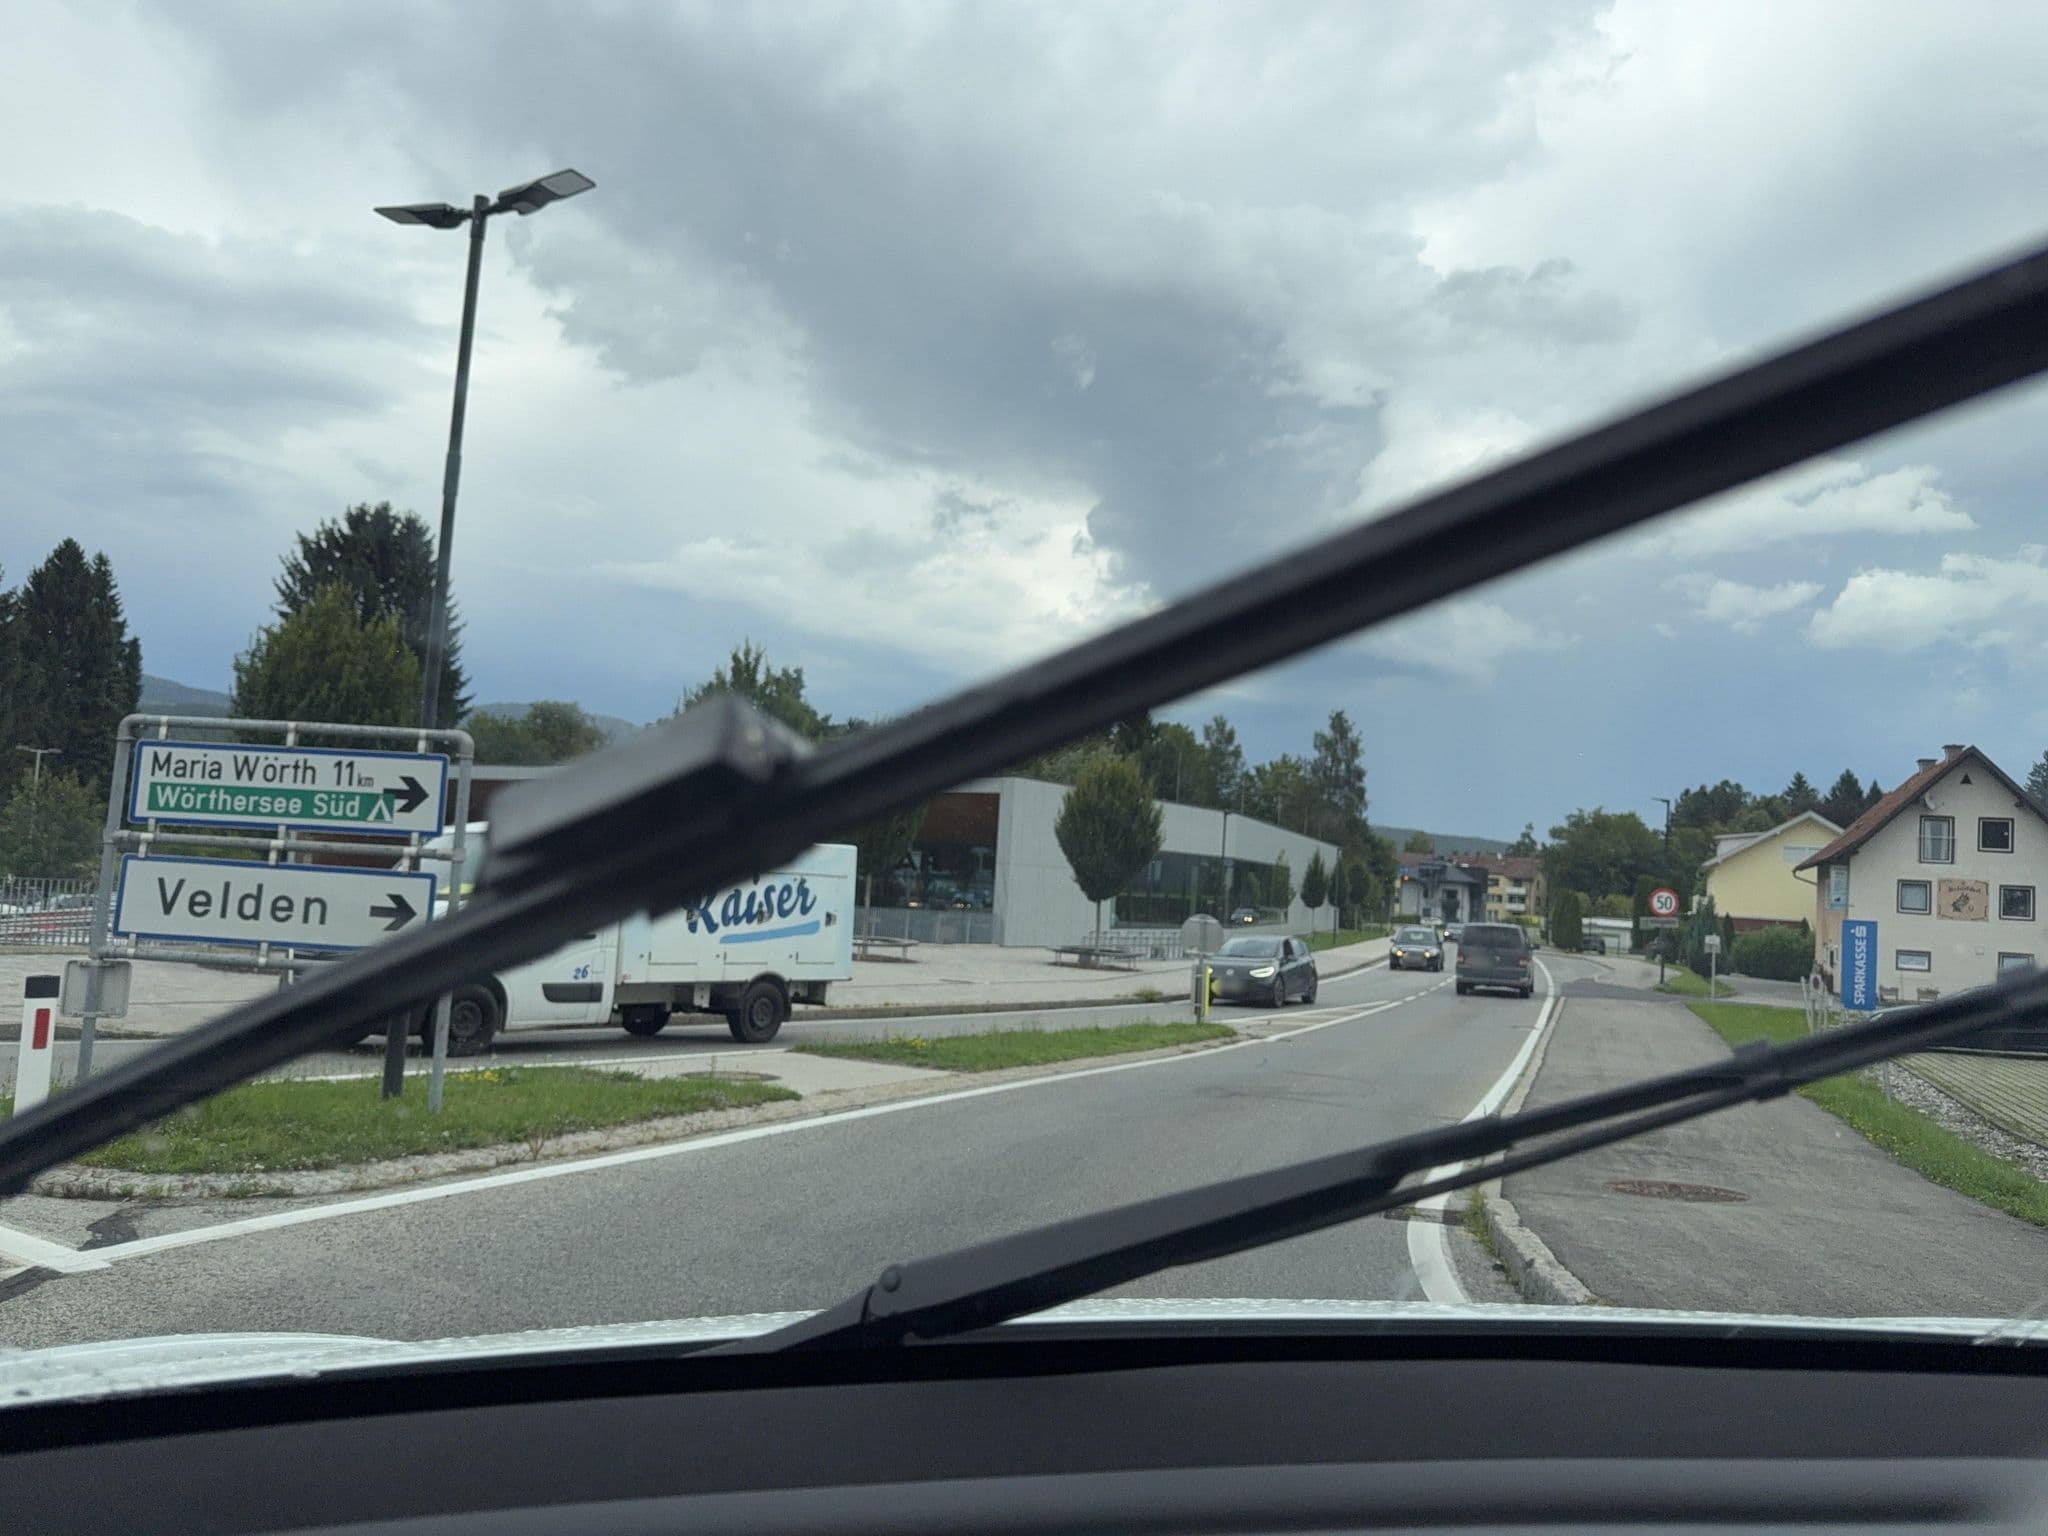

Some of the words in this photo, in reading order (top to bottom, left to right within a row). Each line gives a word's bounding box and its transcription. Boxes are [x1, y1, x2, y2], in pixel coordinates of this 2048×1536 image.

[150, 751, 222, 780] Maria
[233, 754, 316, 785] Wörth
[333, 760, 355, 786] 11
[357, 774, 375, 788] km
[156, 785, 302, 815] Wörthersee
[313, 793, 360, 818] Süd
[157, 876, 328, 926] Velden
[683, 875, 817, 934] Kaiser
[1656, 895, 1673, 911] 50
[573, 964, 590, 980] 26
[1854, 938, 1867, 1005] SPARKASSE
